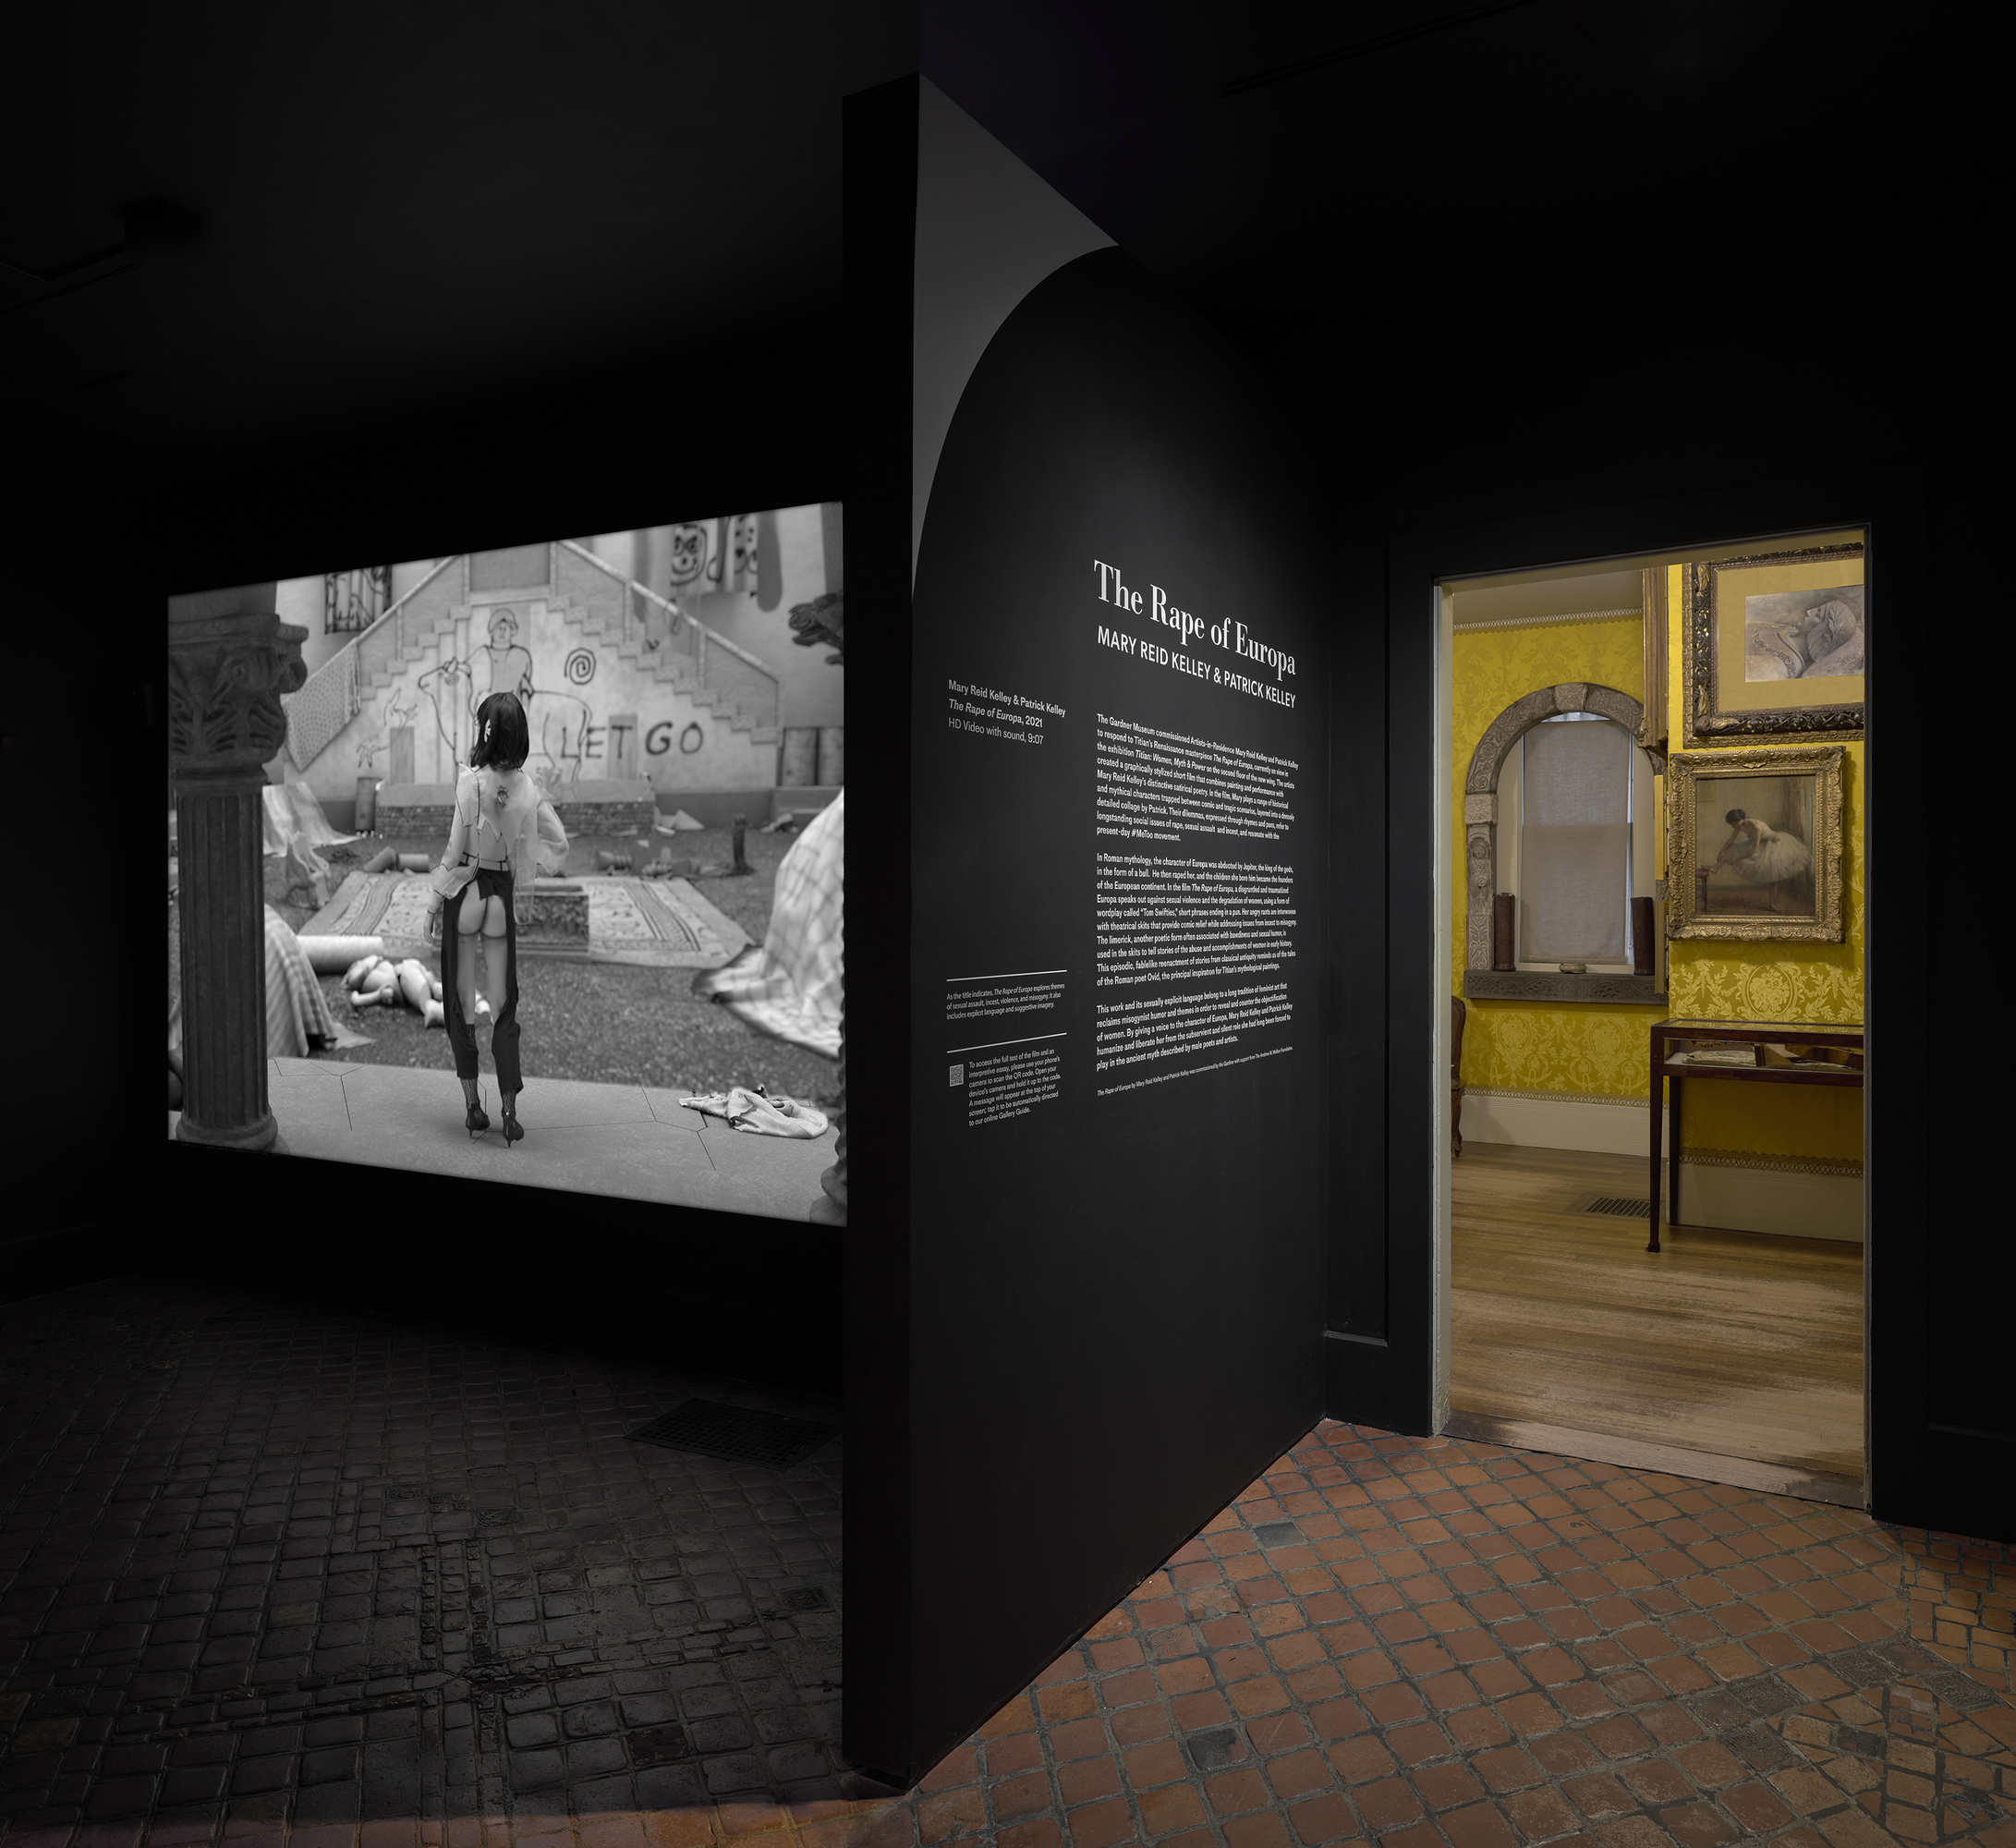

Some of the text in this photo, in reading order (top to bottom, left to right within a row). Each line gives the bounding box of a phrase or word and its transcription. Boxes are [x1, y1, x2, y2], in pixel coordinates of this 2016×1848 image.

[1093, 559, 1296, 682] The Rape of Europa
[1097, 625, 1296, 709] MARY REID KELLEY & PATRICK KELLEY
[948, 679, 1066, 718] Mary Reid Kelley & Patrick Kelley
[949, 698, 1043, 728] The Rape of Europa, 2021
[948, 717, 1044, 745] HD Video with sound, 9:07
[1097, 713, 1109, 724] The
[1109, 716, 1132, 730] Gardner
[1133, 723, 1155, 736] Museum
[560, 720, 704, 760] LET GO
[1097, 728, 1103, 737] to
[1104, 731, 1127, 742] respond
[1127, 736, 1134, 744] to
[1134, 736, 1153, 748] Titian's
[1097, 741, 1107, 751] the
[1108, 745, 1135, 757] exhibition
[1097, 758, 1119, 768] created
[1124, 762, 1153, 775] graphically
[1097, 769, 1112, 782] Mary
[1112, 772, 1125, 783] Reid
[1126, 774, 1147, 786] Kelley's
[1097, 784, 1108, 793] and
[1109, 786, 1132, 796] mythical
[1133, 789, 1160, 801] characters
[1097, 796, 1120, 808] detailed
[1121, 801, 1140, 813] collage
[1141, 803, 1148, 814] by
[1097, 810, 1133, 825] longstanding
[1133, 816, 1148, 825] social
[1149, 817, 1165, 827] issues
[1097, 827, 1131, 838] present-day
[1131, 829, 1153, 839] #MeToo
[1097, 853, 1102, 861] In
[1103, 853, 1123, 863] Roman
[1153, 857, 1162, 865] the
[1097, 880, 1103, 889] of
[1104, 880, 1113, 890] the
[1114, 881, 1140, 892] European
[1097, 894, 1117, 905] Europa
[1118, 894, 1136, 905] speaks
[1147, 895, 1165, 905] against
[1097, 935, 1109, 944] The
[1134, 933, 1154, 943] another
[1097, 1004, 1110, 1014] This
[1110, 1002, 1124, 1012] work
[1124, 1001, 1136, 1011] and
[1143, 997, 1163, 1008] sexually
[1097, 1032, 1103, 1042] of
[1126, 1027, 1135, 1038] By
[1135, 1026, 1150, 1037] giving
[1097, 1060, 1109, 1072] play
[1110, 1058, 1115, 1067] in
[1116, 1056, 1125, 1065] the
[1126, 1052, 1147, 1064] ancient
[1147, 1049, 1160, 1061] myth
